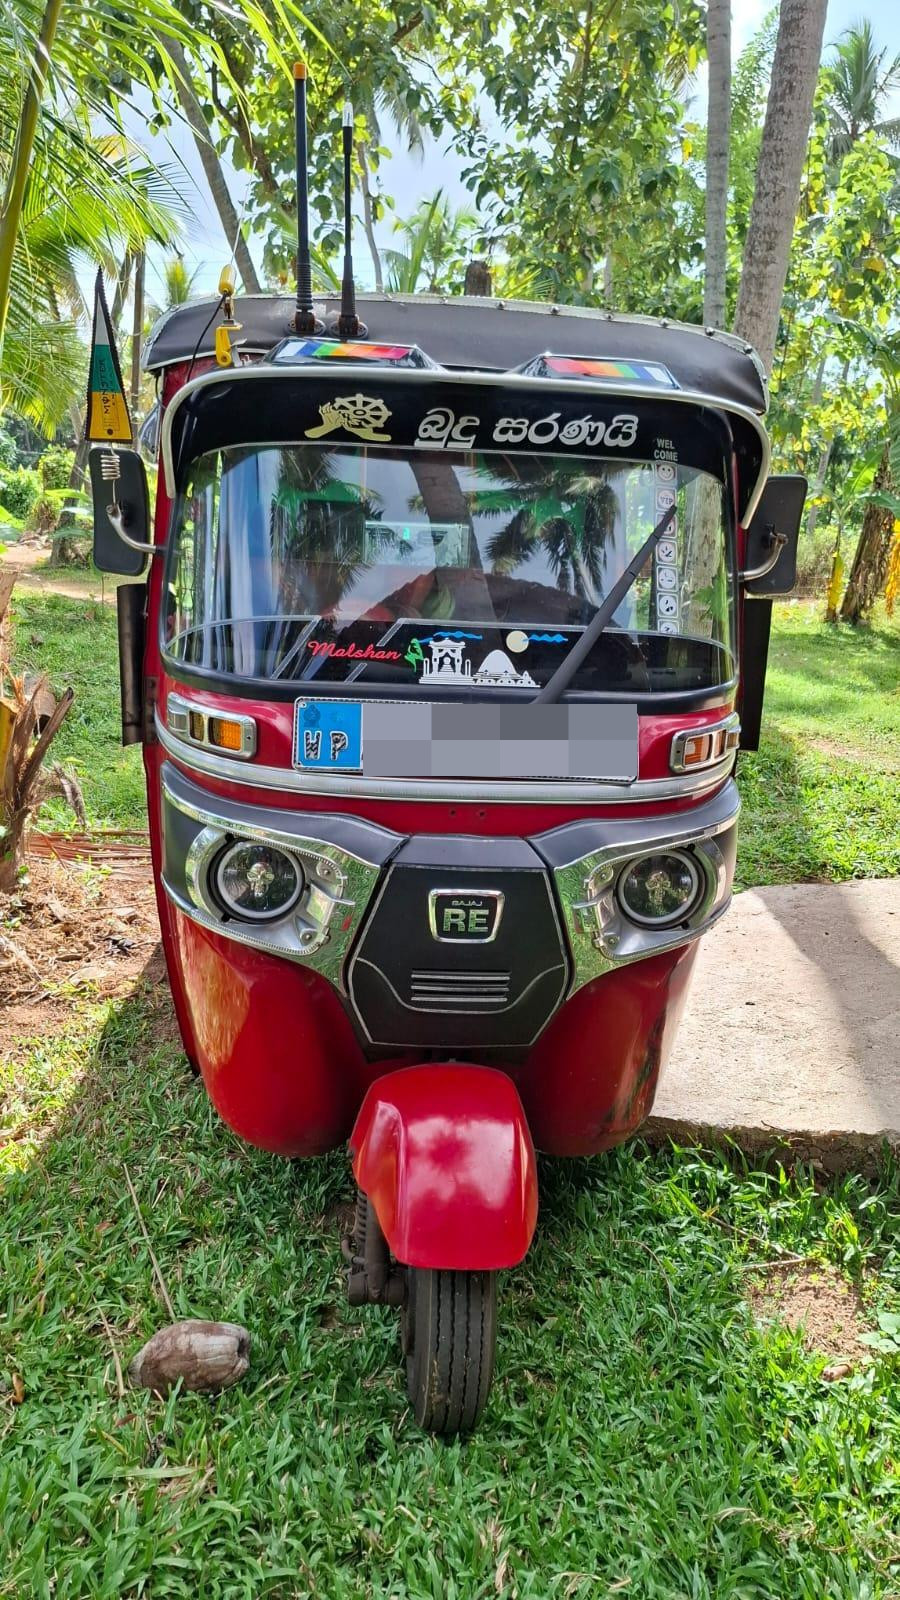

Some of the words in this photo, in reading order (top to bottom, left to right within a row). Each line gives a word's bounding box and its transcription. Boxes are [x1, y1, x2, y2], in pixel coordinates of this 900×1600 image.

[414, 408, 480, 449] බුදු
[492, 413, 639, 447] සරණයි
[656, 438, 675, 450] WEL
[654, 449, 678, 461] COME
[308, 641, 402, 659] Malshan
[443, 908, 489, 932] RE
